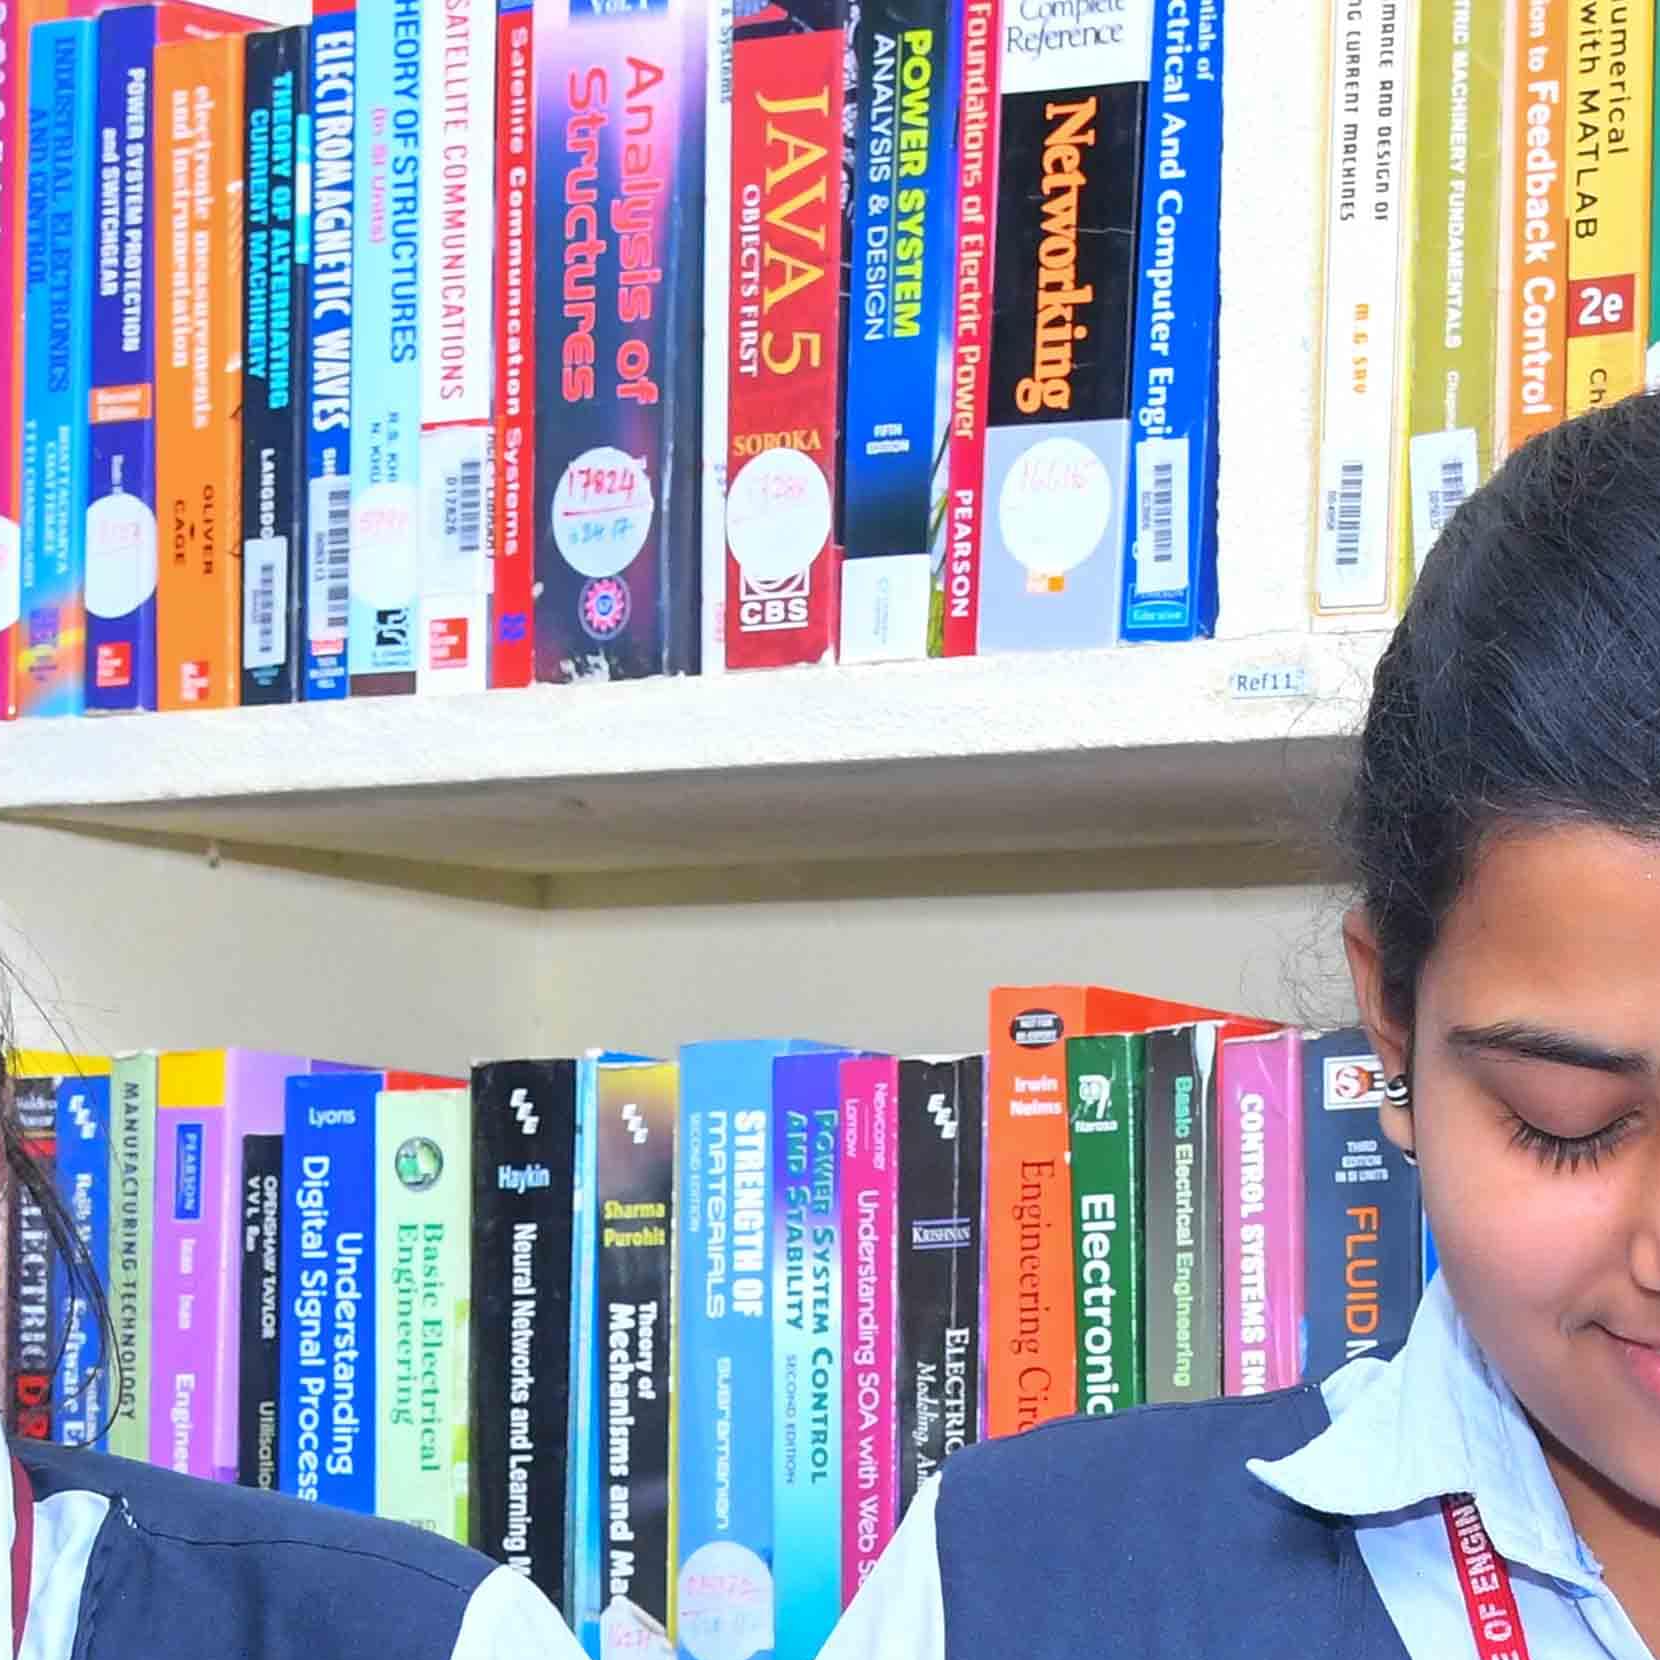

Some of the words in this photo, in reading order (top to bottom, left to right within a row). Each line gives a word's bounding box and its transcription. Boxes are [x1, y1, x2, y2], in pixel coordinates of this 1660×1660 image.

[508, 27, 528, 155] Satellite
[1579, 7, 1600, 73] with
[124, 68, 146, 135] POWER
[869, 33, 895, 183] ANALYSIS
[897, 29, 933, 177] POWER
[1159, 113, 1186, 179] And
[123, 143, 144, 220] SYSTEM
[314, 30, 354, 320] ELECTROMAGNETIC
[610, 56, 663, 322] Analysis
[755, 86, 830, 312] JAVA
[866, 195, 889, 217] &
[1576, 90, 1600, 238] MATLAB
[121, 226, 143, 352] PROTECTION
[506, 166, 526, 416] Communication
[561, 68, 607, 402] Structures
[738, 183, 760, 297] OBJECTS
[864, 225, 886, 341] DESIGN
[893, 190, 926, 338] SYSTEM
[1015, 97, 1096, 411] Networking
[1150, 186, 1183, 356] Computer
[738, 302, 759, 377] FIRST
[762, 331, 820, 375] 5
[1578, 288, 1623, 325] 2e
[312, 329, 351, 432] WAVES
[616, 340, 658, 404] of
[504, 427, 524, 557] Systems
[740, 597, 808, 625] CBS
[951, 489, 974, 618] PEARSON
[498, 1166, 550, 1192] Haykin
[1239, 1093, 1266, 1217] CONTROL
[421, 1223, 444, 1304] Basic
[512, 1223, 537, 1296] Neural
[853, 1189, 879, 1365] Understanding
[1010, 1159, 1056, 1356] Engineering
[1240, 1224, 1266, 1346] SYSTEMS
[1345, 1206, 1378, 1328] FLUID
[326, 1233, 362, 1476] Understanding
[391, 1224, 418, 1425] Engineering
[511, 1302, 536, 1403] Networks
[419, 1310, 443, 1472] Electrical
[510, 1409, 534, 1450] and
[609, 1303, 635, 1477] Mechanisms
[858, 1370, 879, 1432] SOA
[503, 1456, 533, 1551] Learning
[610, 1485, 634, 1541] and
[858, 1436, 879, 1487] with
[858, 1494, 879, 1552] Web
[1480, 1598, 1518, 1644] OF
